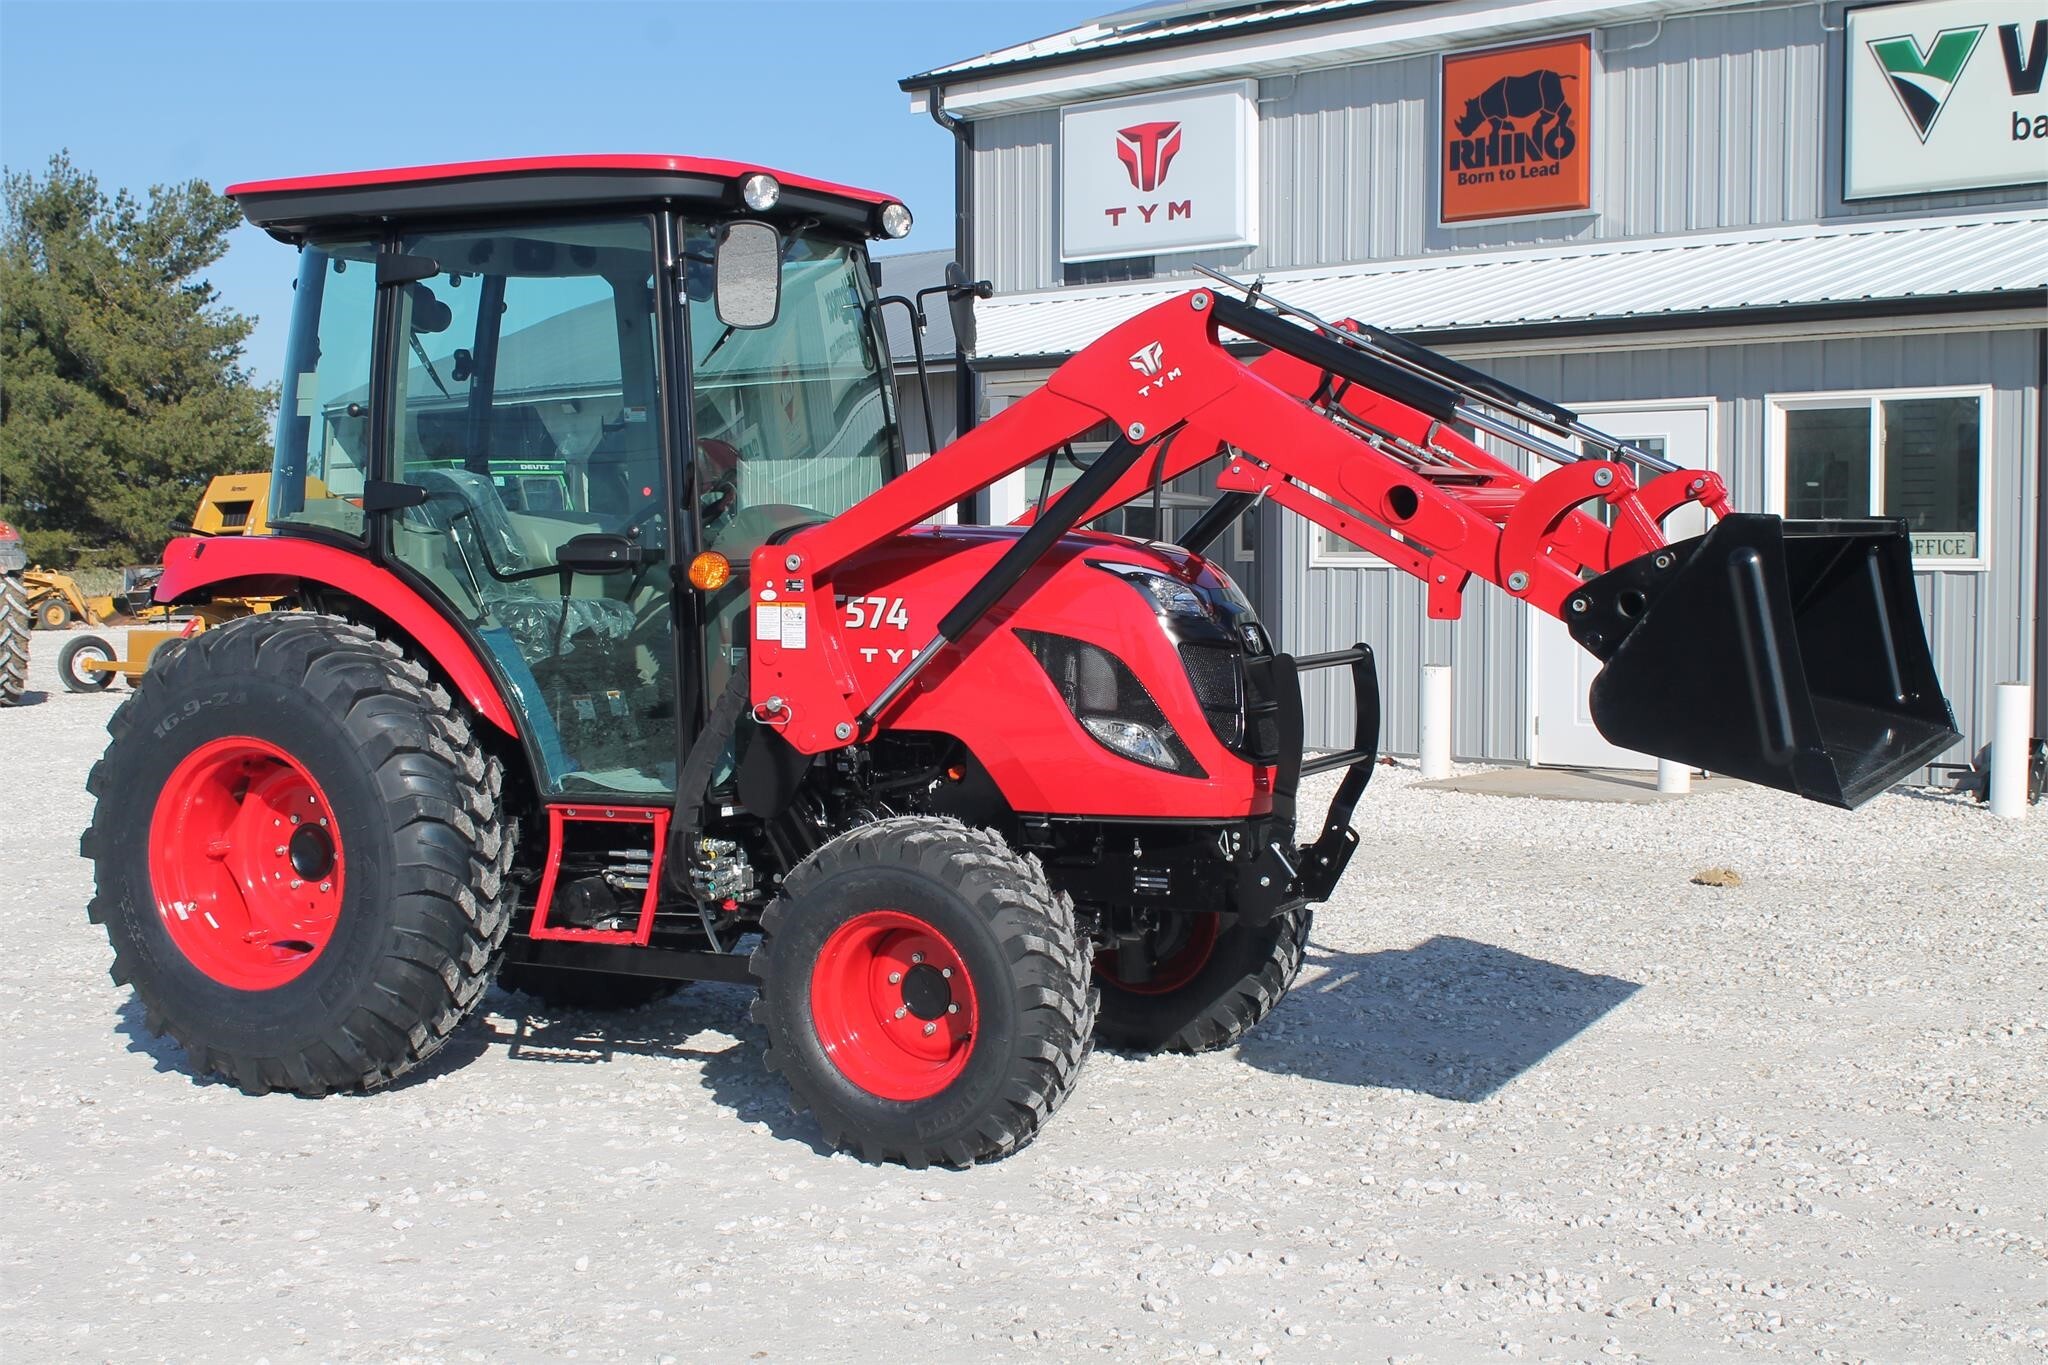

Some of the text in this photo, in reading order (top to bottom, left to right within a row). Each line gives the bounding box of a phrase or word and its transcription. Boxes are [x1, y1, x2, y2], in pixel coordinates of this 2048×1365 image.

[1449, 124, 1576, 172] RHINO
[1457, 162, 1560, 186] Born to Lead
[1104, 199, 1192, 227] TYM
[1137, 367, 1182, 397] TYM
[1909, 538, 1967, 556] FFICE
[845, 595, 909, 631] 574
